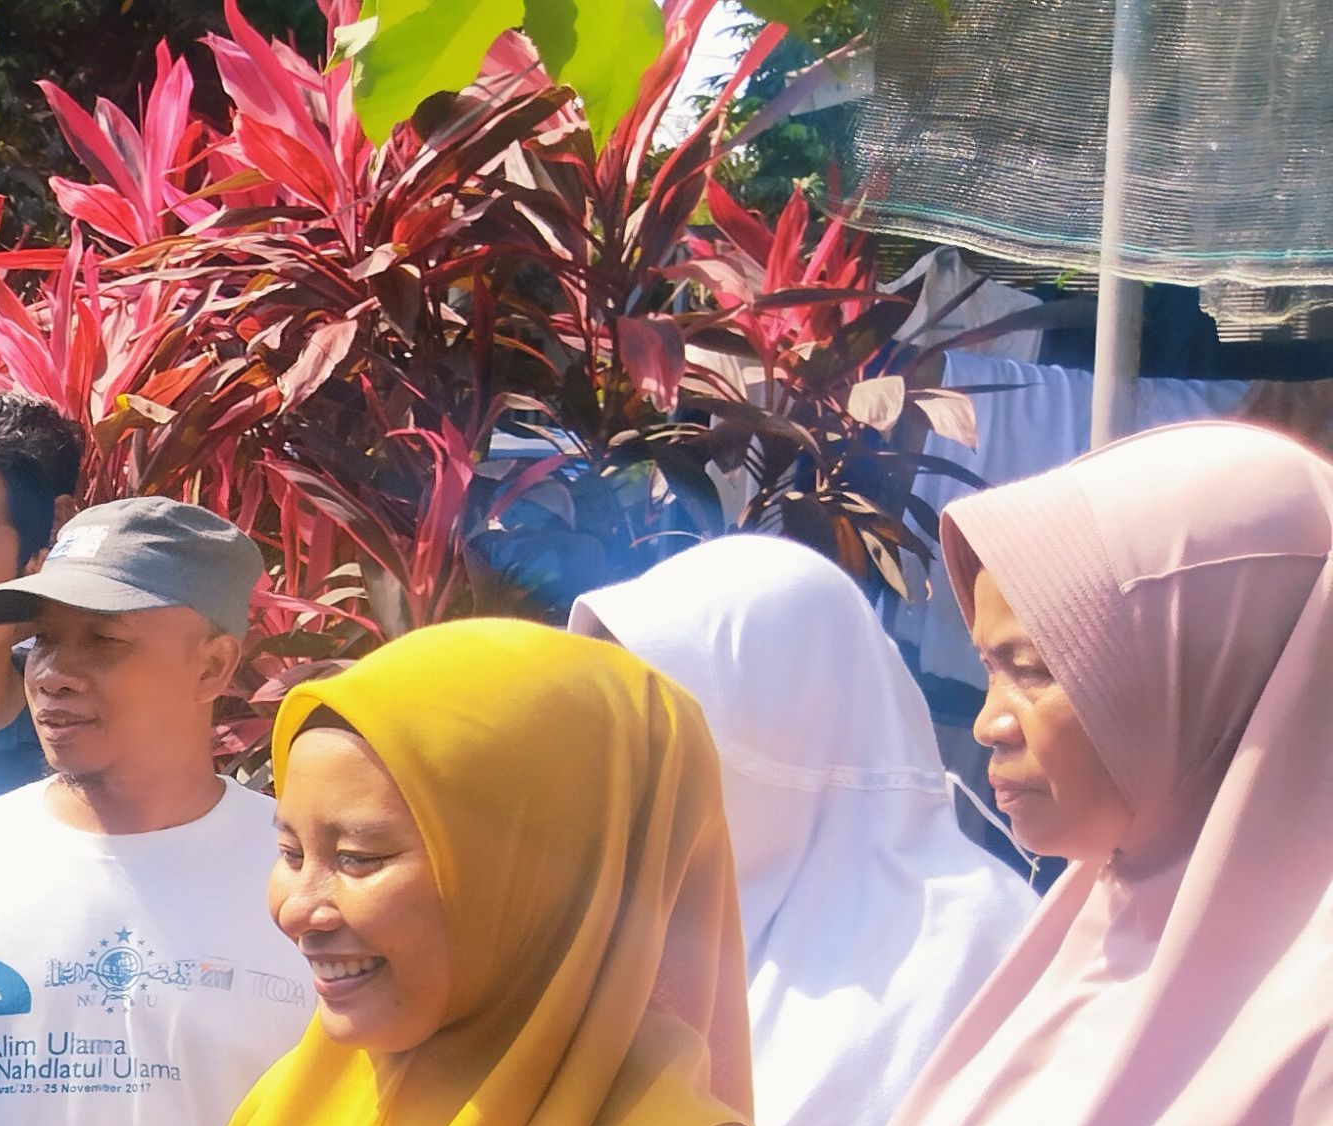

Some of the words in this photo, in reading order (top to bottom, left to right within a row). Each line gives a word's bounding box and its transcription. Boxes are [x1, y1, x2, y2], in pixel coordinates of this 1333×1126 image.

[48, 1031, 126, 1056] Ulama
[113, 1057, 181, 1081] Ulama
[60, 1082, 122, 1094] November
[124, 1082, 152, 1094] 2017
